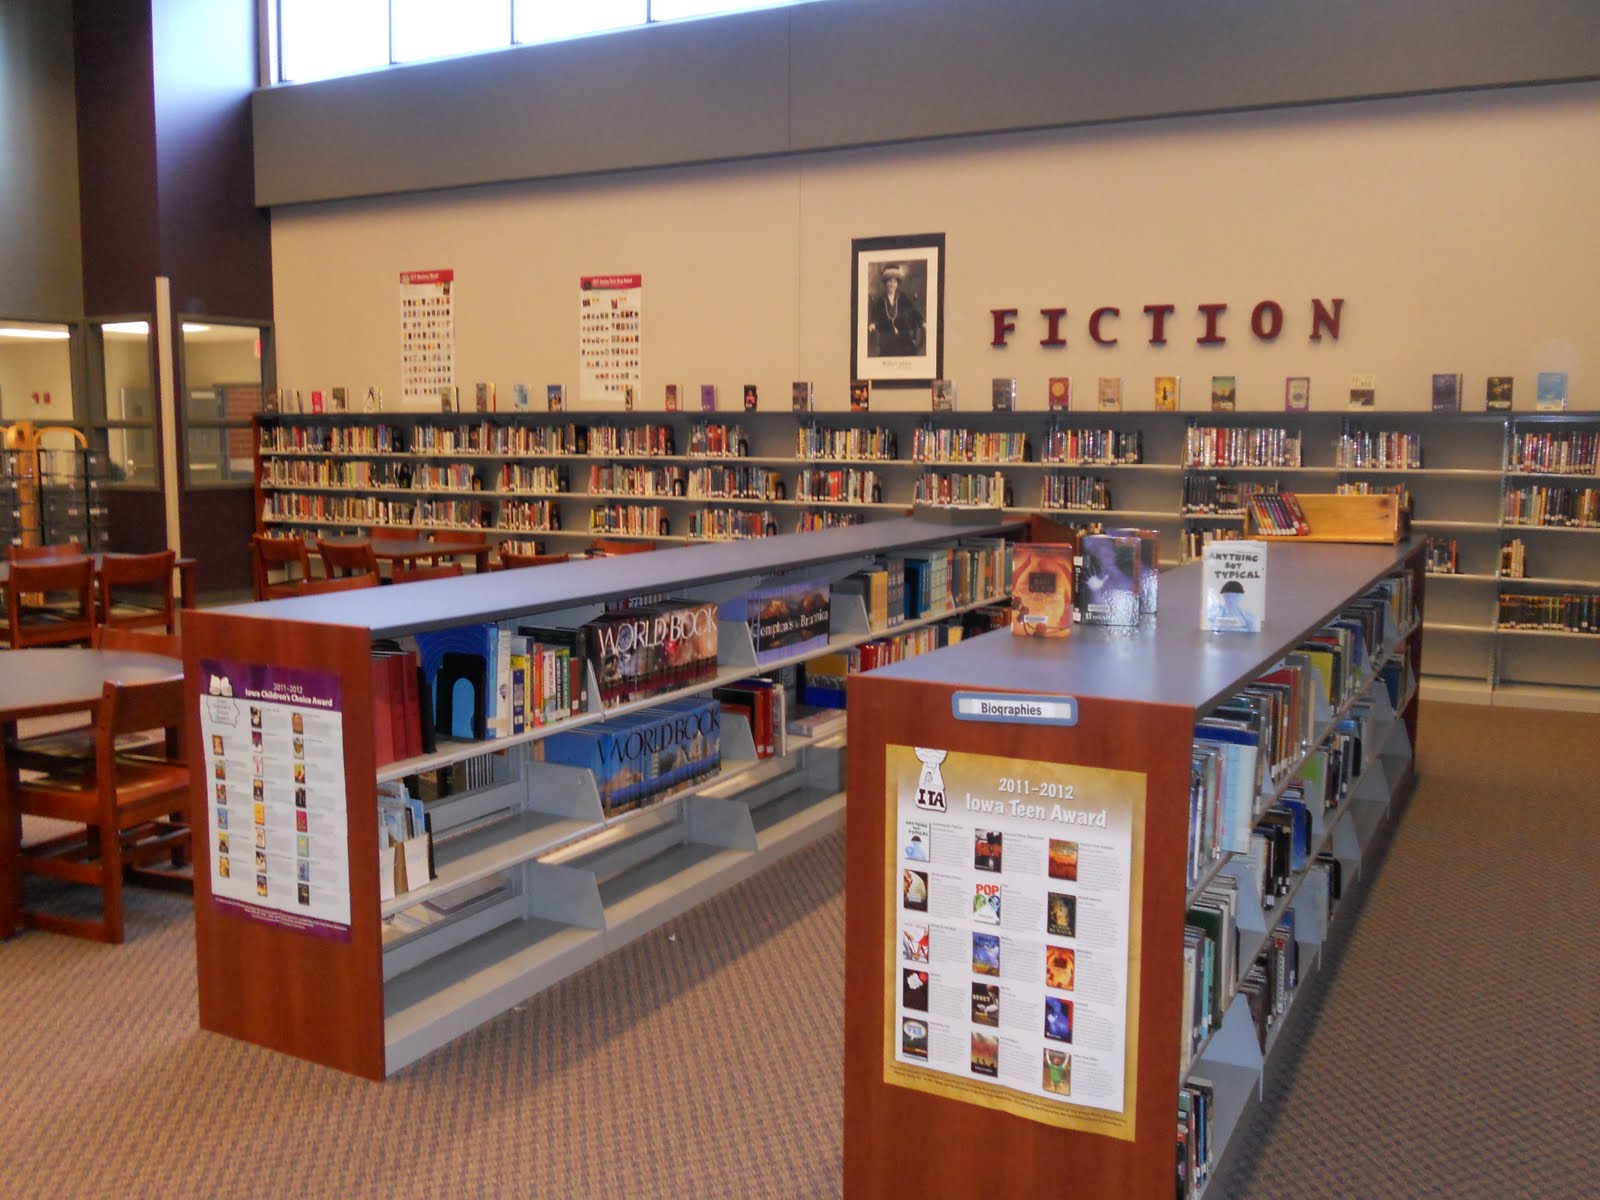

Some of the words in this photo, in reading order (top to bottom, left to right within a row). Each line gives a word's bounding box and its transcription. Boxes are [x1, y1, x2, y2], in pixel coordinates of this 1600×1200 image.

[990, 298, 1345, 347] FICTION
[1208, 551, 1259, 563] ANYTHING
[1214, 570, 1261, 579] TYPICAL
[598, 619, 668, 658] WORLD
[669, 606, 718, 643] BOOK
[245, 687, 260, 698] Iowa
[260, 689, 290, 702] Children's
[291, 693, 312, 705] Choice
[312, 696, 334, 708] Award
[273, 682, 304, 694] 2011-2012
[980, 702, 1043, 717] Biographies
[596, 721, 673, 766] WORLD
[674, 705, 721, 745] BOOK
[918, 788, 945, 808] ITA
[998, 777, 1074, 800] 2011-2012
[965, 792, 1005, 816] Iowa
[1008, 799, 1046, 821] Teen
[1049, 803, 1107, 829] Award
[975, 883, 999, 896] POP
